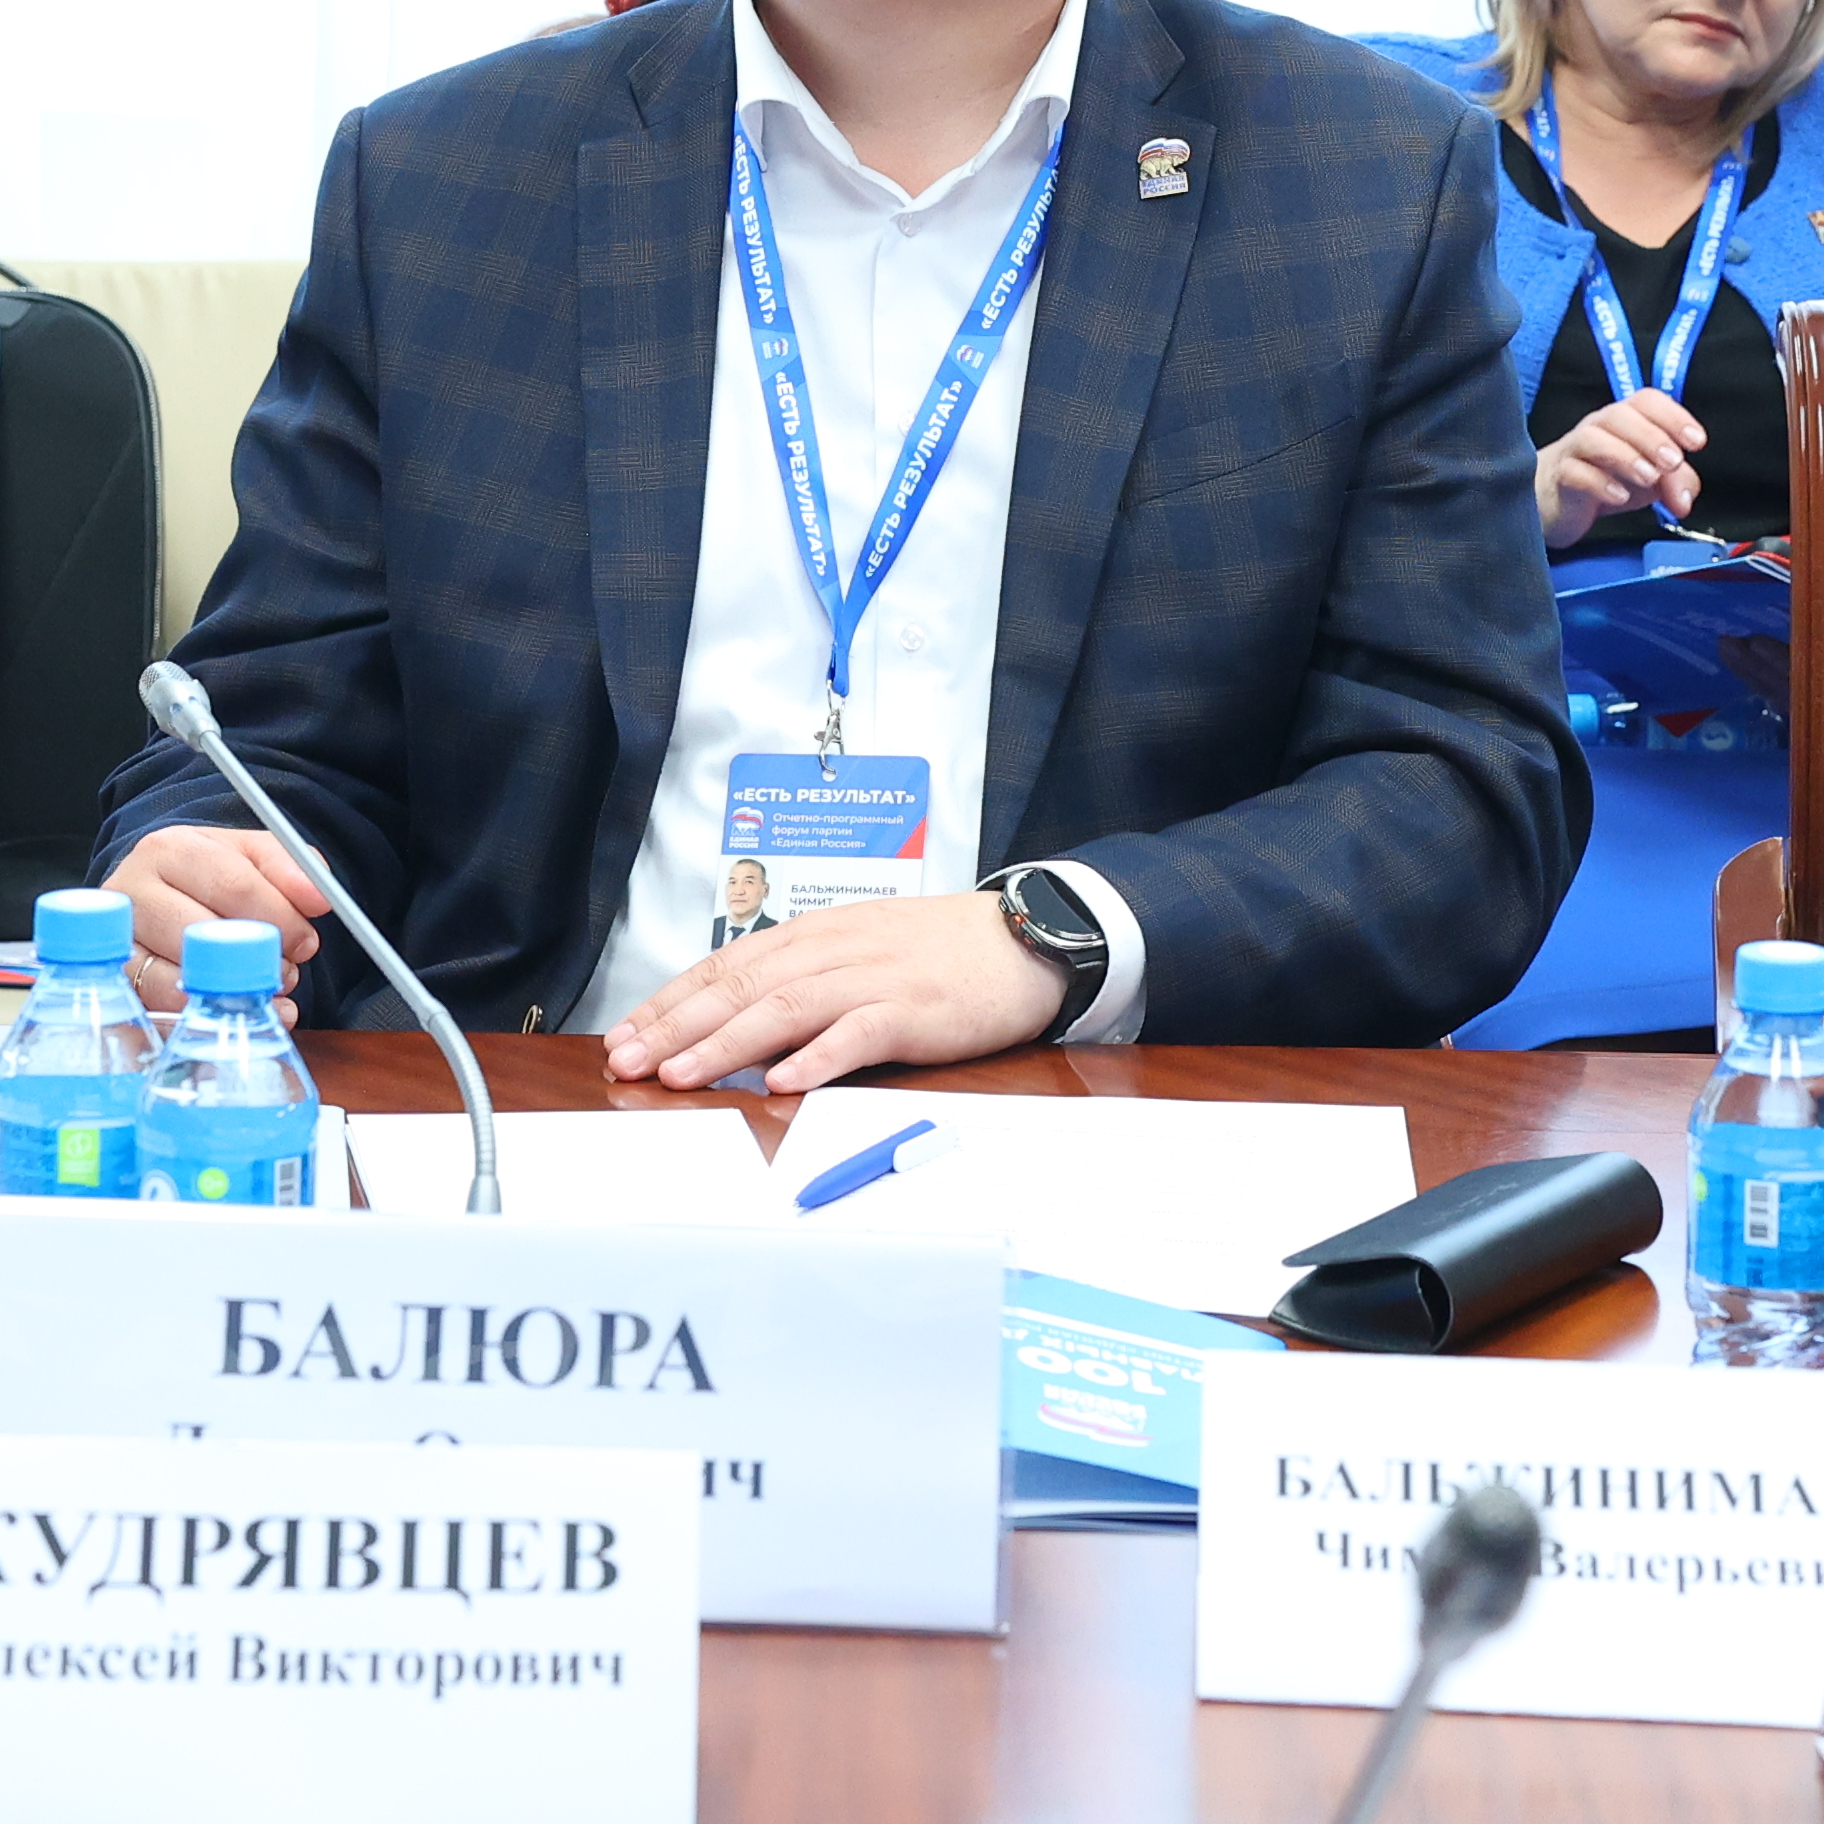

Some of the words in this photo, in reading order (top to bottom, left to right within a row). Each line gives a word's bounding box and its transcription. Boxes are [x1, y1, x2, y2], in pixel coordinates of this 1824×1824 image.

[734, 134, 751, 194] «ЕСТЬ
[740, 195, 777, 324] РЕЗУЛЬТАТ»
[981, 268, 1019, 330] «ЕСТЬ
[775, 370, 802, 438] «ЕСТЬ
[788, 439, 827, 577] РЕЗУЛЬТАТ»
[864, 512, 902, 579] «ЕСТЬ
[892, 380, 964, 510] РЕЗУЛЬТАТ»
[733, 787, 792, 803] «ЕСТЬ
[796, 788, 916, 805] РЕЗУЛЬТАТ»
[772, 811, 905, 826] Отчетно-программный
[770, 838, 818, 848] «Единая
[820, 838, 867, 849] Россия»
[771, 825, 810, 837] форум
[811, 826, 853, 837] партии
[789, 896, 834, 907] ЧИМИТ
[790, 884, 898, 896] БАЛЬЖИНИМАЕВ
[217, 1296, 717, 1394] БАЛЮРА
[1017, 1346, 1167, 1396] 100
[228, 1633, 625, 1701] Викторович
